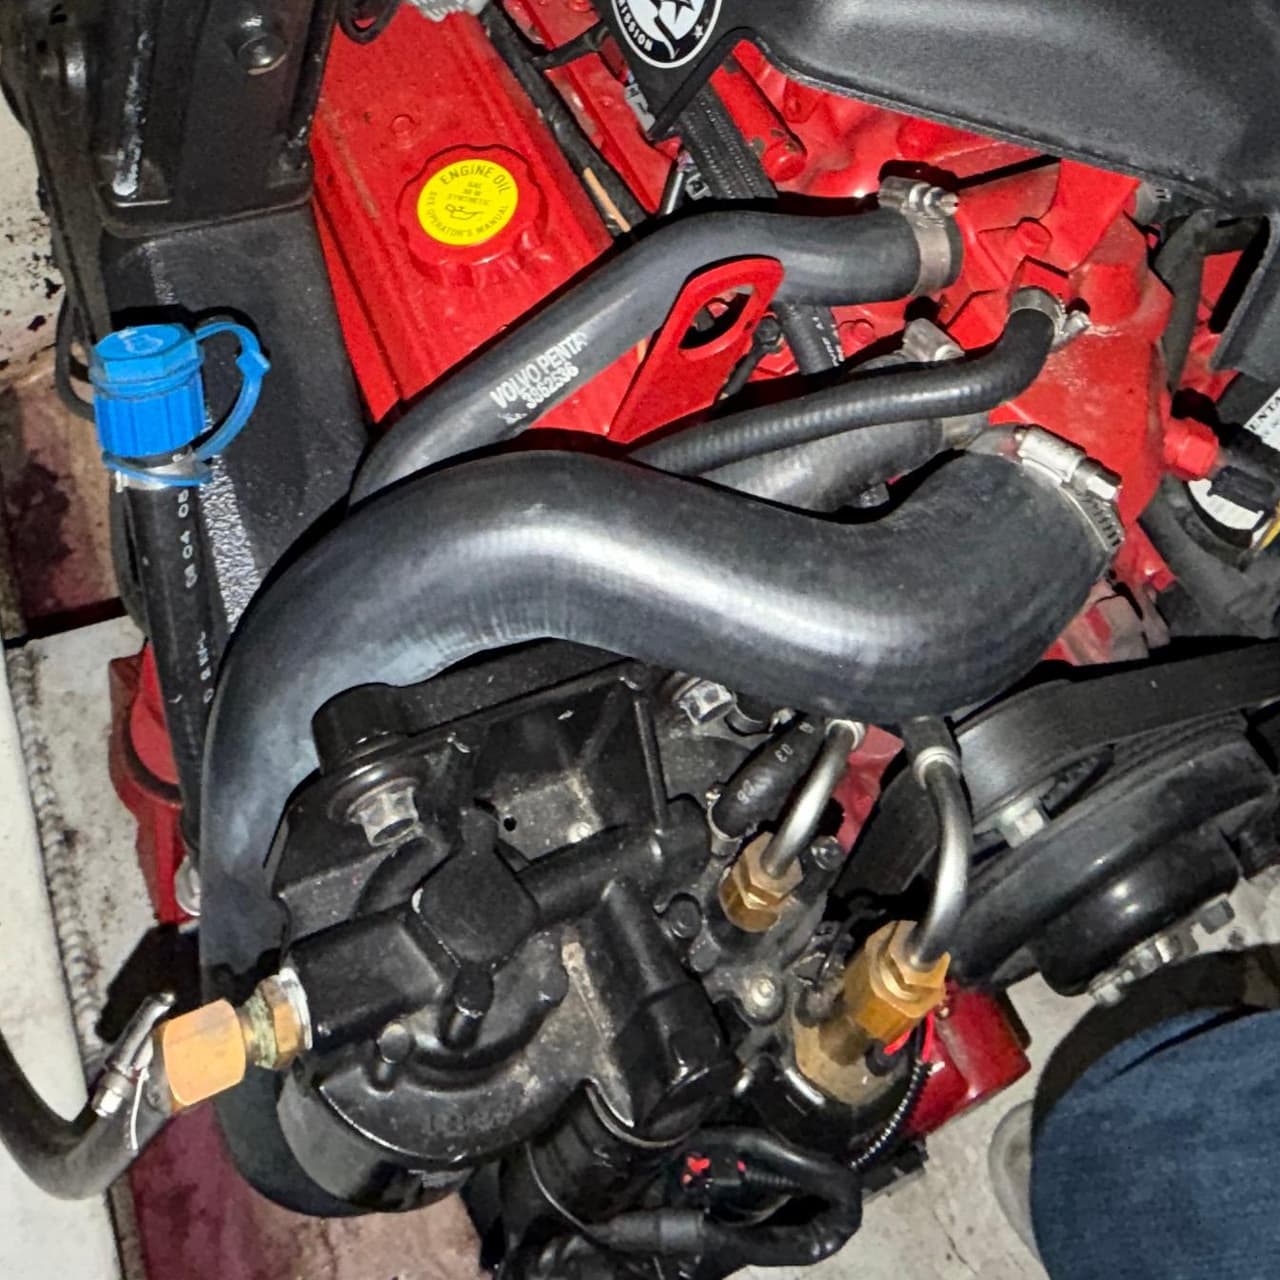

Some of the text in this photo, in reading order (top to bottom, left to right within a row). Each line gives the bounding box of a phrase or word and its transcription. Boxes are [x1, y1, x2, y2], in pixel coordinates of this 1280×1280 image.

[439, 165, 495, 185] ENGINE
[493, 174, 511, 195] OIL
[489, 332, 588, 409] VOLVO PENTA
